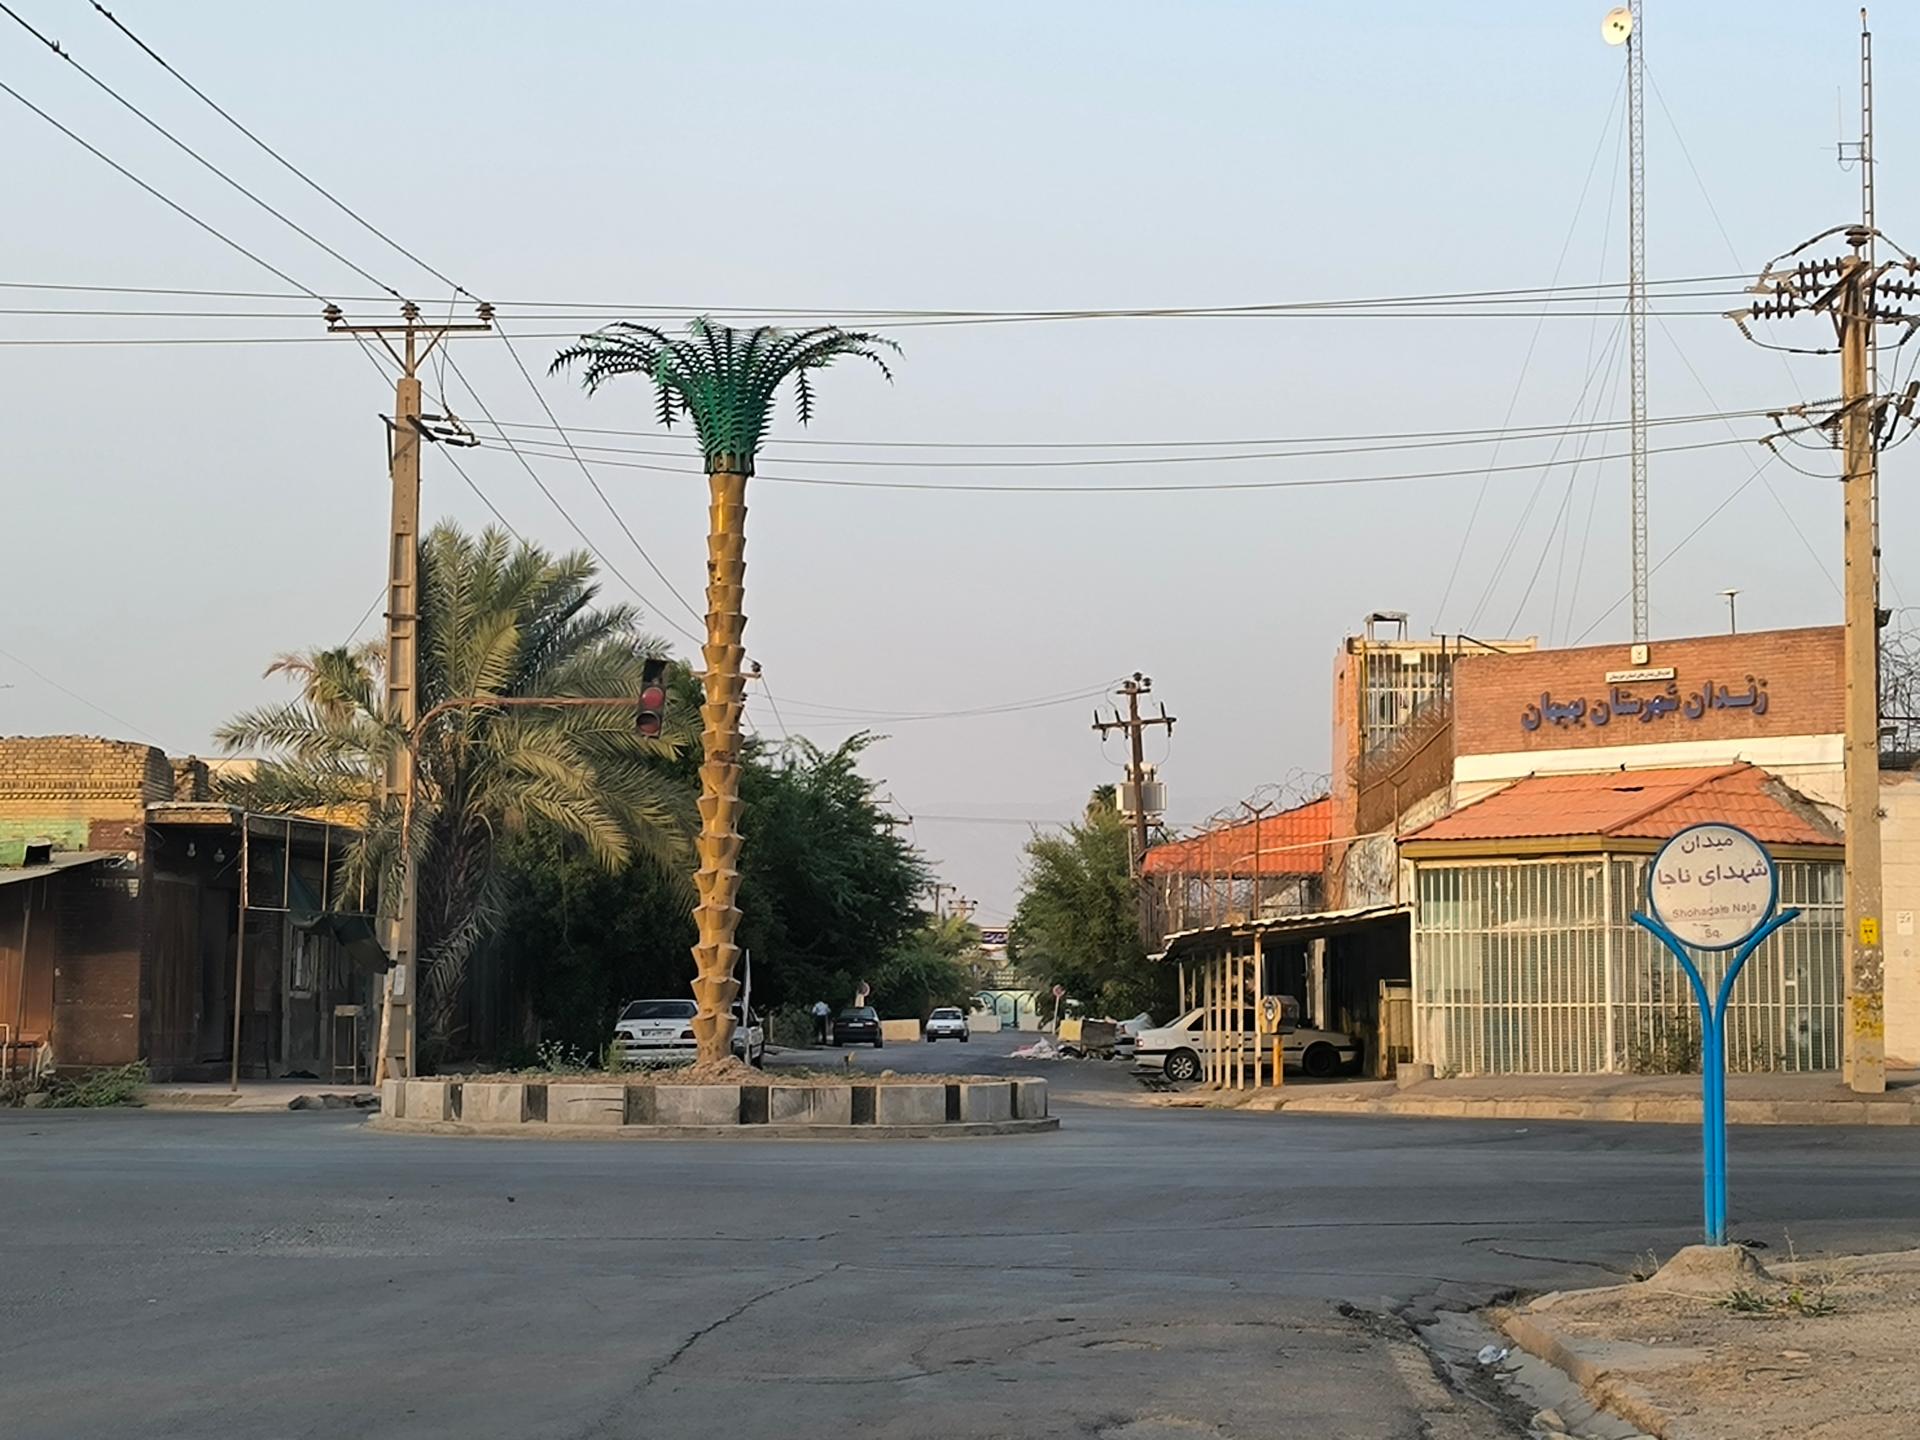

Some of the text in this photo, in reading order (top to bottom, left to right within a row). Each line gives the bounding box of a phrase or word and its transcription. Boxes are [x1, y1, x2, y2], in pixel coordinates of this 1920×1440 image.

[1521, 674, 1769, 731] زندان شهرستان بهبهان
[1681, 834, 1734, 854] میدان
[1658, 860, 1768, 889] شهدای ناجا
[1733, 902, 1757, 914] Naja
[1705, 928, 1723, 938] Sq.
